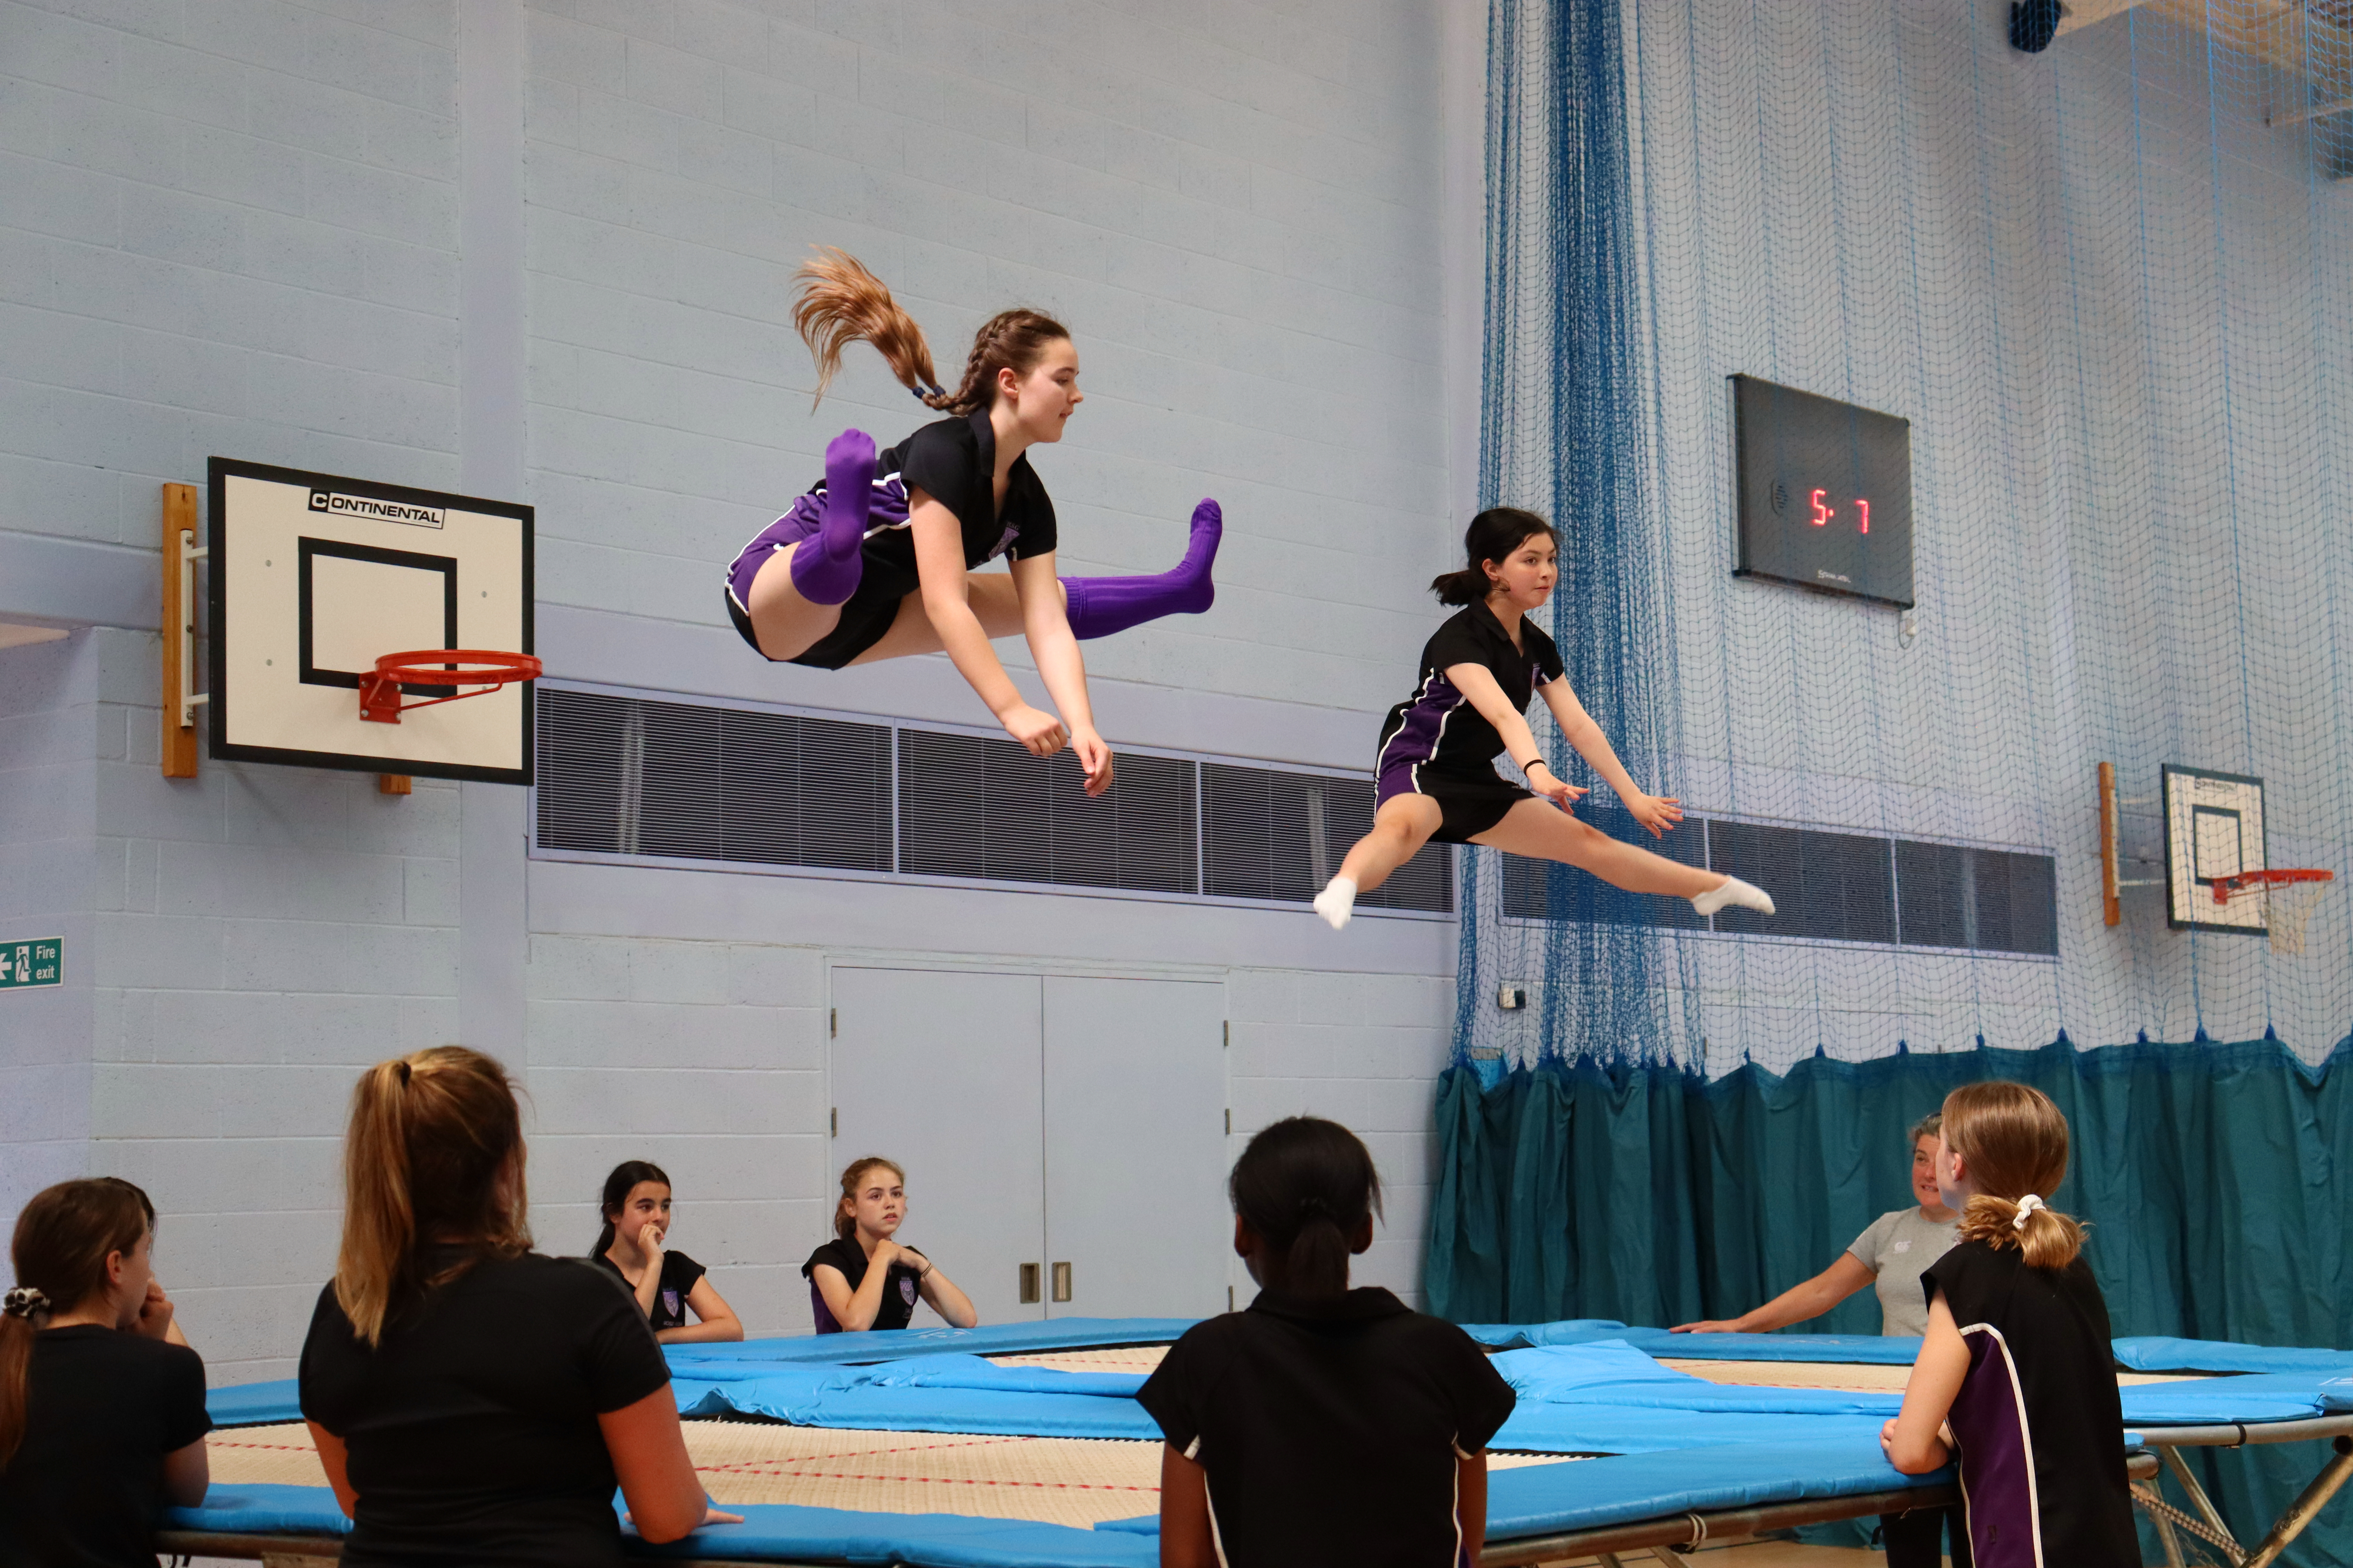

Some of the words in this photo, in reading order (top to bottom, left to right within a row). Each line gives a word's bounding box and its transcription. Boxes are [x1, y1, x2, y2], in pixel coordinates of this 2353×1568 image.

[311, 492, 441, 523] CONTINENTAL
[36, 945, 55, 959] Fire
[36, 965, 55, 979] exit
